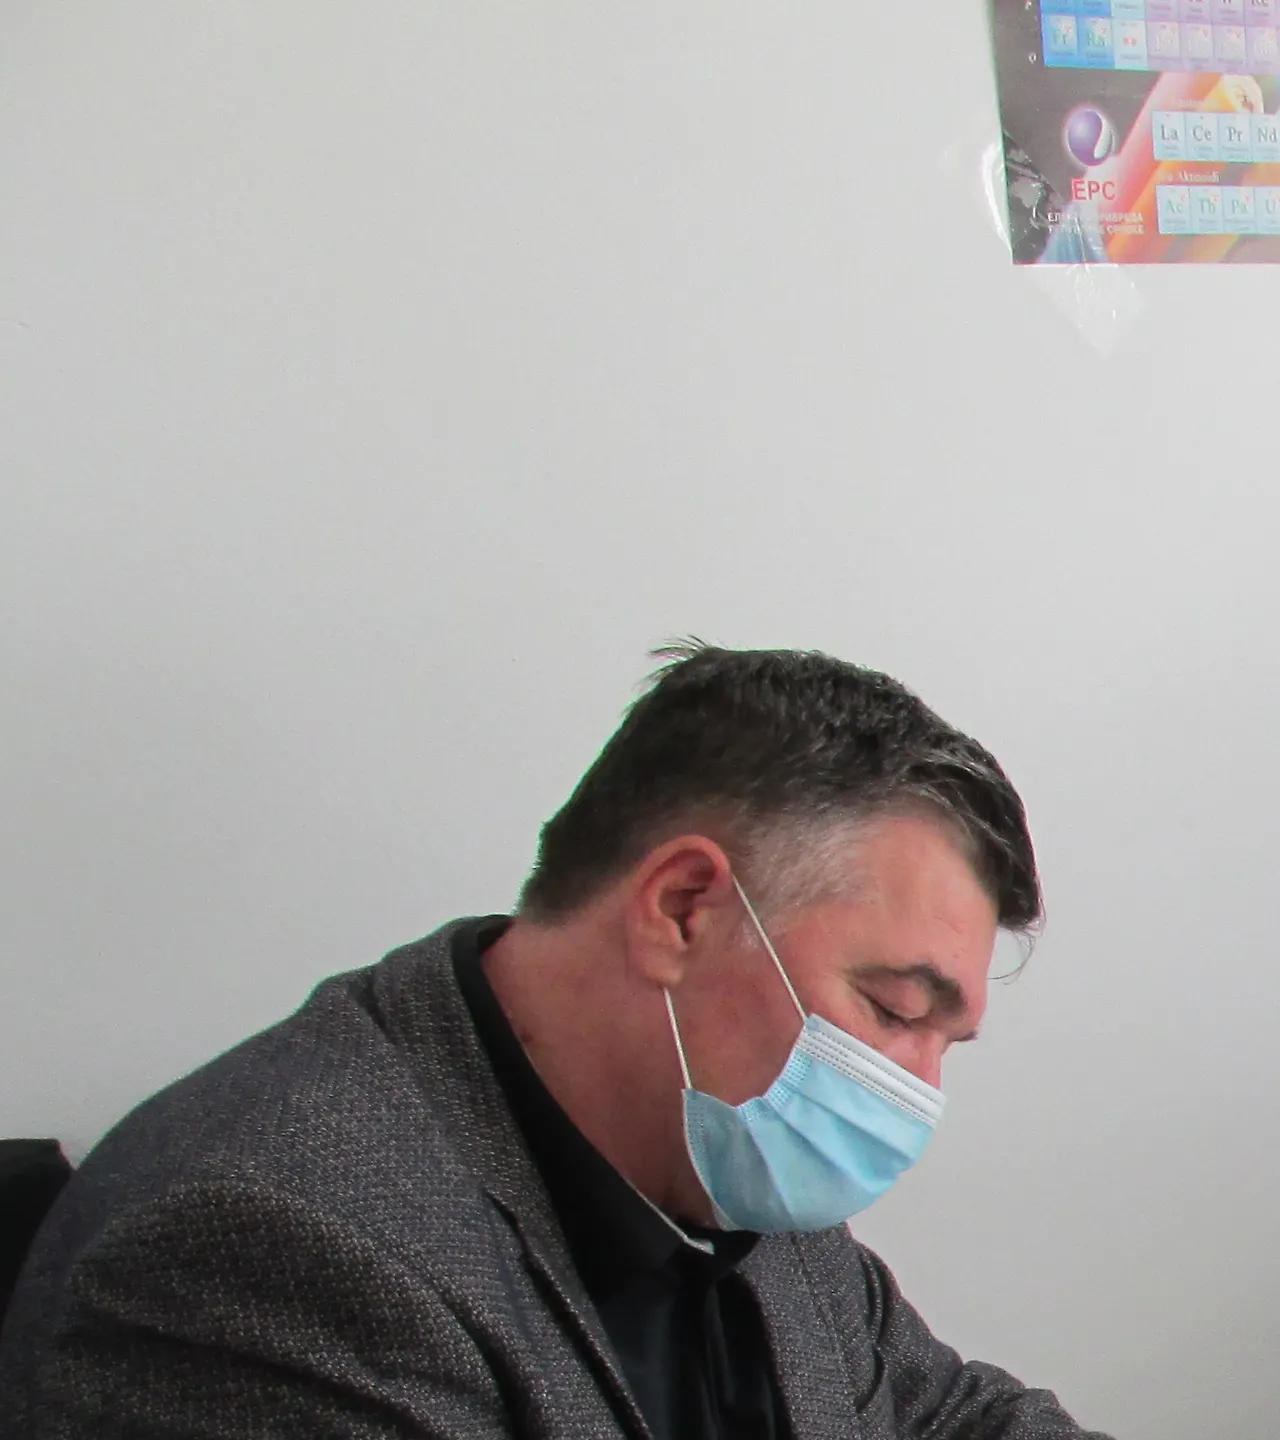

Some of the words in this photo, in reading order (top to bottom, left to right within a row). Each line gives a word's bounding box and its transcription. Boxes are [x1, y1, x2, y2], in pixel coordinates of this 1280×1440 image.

[1160, 125, 1179, 140] La
[1192, 126, 1212, 141] Ce
[1228, 127, 1244, 142] Pr
[1257, 127, 1278, 143] Nd
[1072, 180, 1116, 200] EPC
